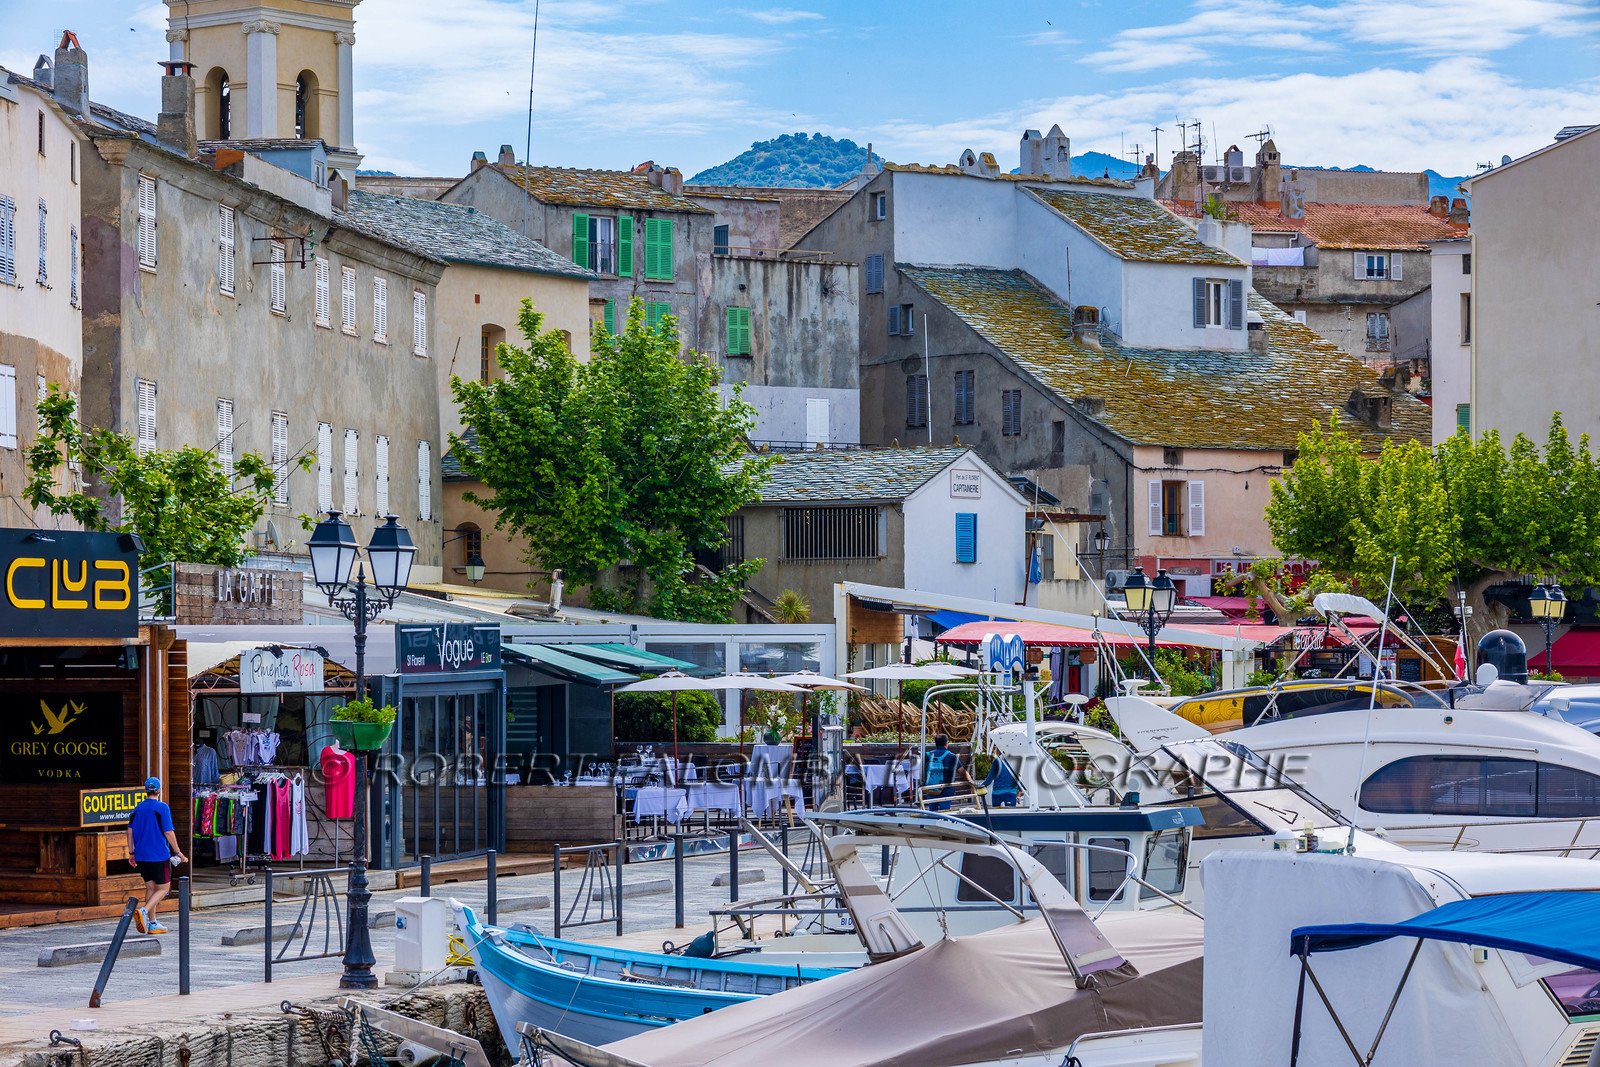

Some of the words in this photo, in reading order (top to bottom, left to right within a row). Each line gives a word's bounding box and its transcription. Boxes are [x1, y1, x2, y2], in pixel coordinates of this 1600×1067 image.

[6, 557, 131, 610] CLUB
[218, 570, 232, 602] LA
[239, 571, 277, 604] GAFFE
[436, 619, 474, 670] Vogue
[291, 653, 316, 686] Rosa
[11, 741, 50, 756] GREY
[53, 741, 108, 756] GOOSE
[38, 769, 81, 778] VODKA
